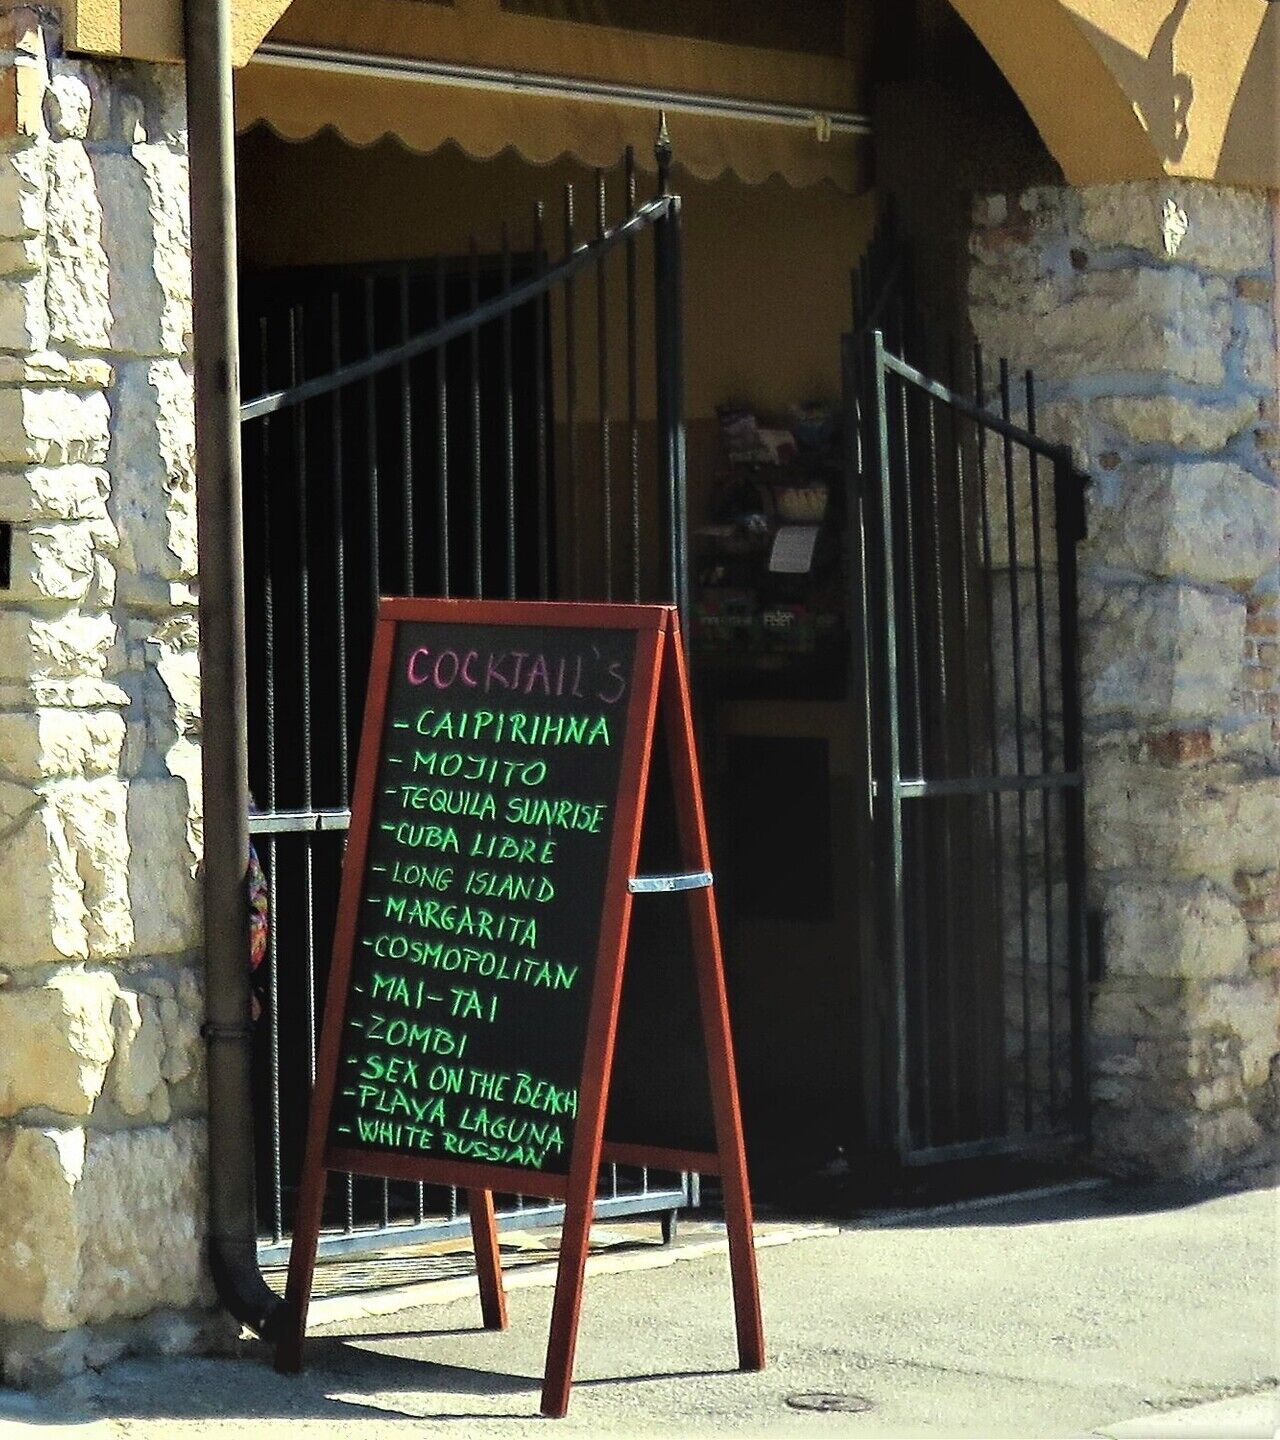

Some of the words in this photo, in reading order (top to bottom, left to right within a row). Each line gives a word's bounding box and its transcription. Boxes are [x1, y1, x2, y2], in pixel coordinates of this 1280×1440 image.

[407, 646, 626, 704] COCKTAIL'S
[413, 751, 546, 787] MOJITO
[400, 785, 497, 820] TEQUILA
[505, 797, 608, 833] SUNRISE
[395, 822, 460, 854] CUBA
[470, 833, 557, 864] LIBRE
[392, 860, 454, 891] LONG
[465, 871, 555, 903] ISLAND
[385, 896, 537, 949] MARGARITA
[374, 935, 580, 990] COSMOPOLITAN
[367, 1014, 468, 1059] ZOMBI
[360, 1055, 418, 1088] SEX
[429, 1065, 463, 1094] ON
[470, 1071, 510, 1101] THE
[513, 1073, 579, 1119] BEACH
[357, 1117, 434, 1149] WHITE
[444, 1134, 543, 1169] RUSSIAN
[358, 1084, 445, 1126] PLAYA
[459, 1108, 564, 1154] LAGUNA
